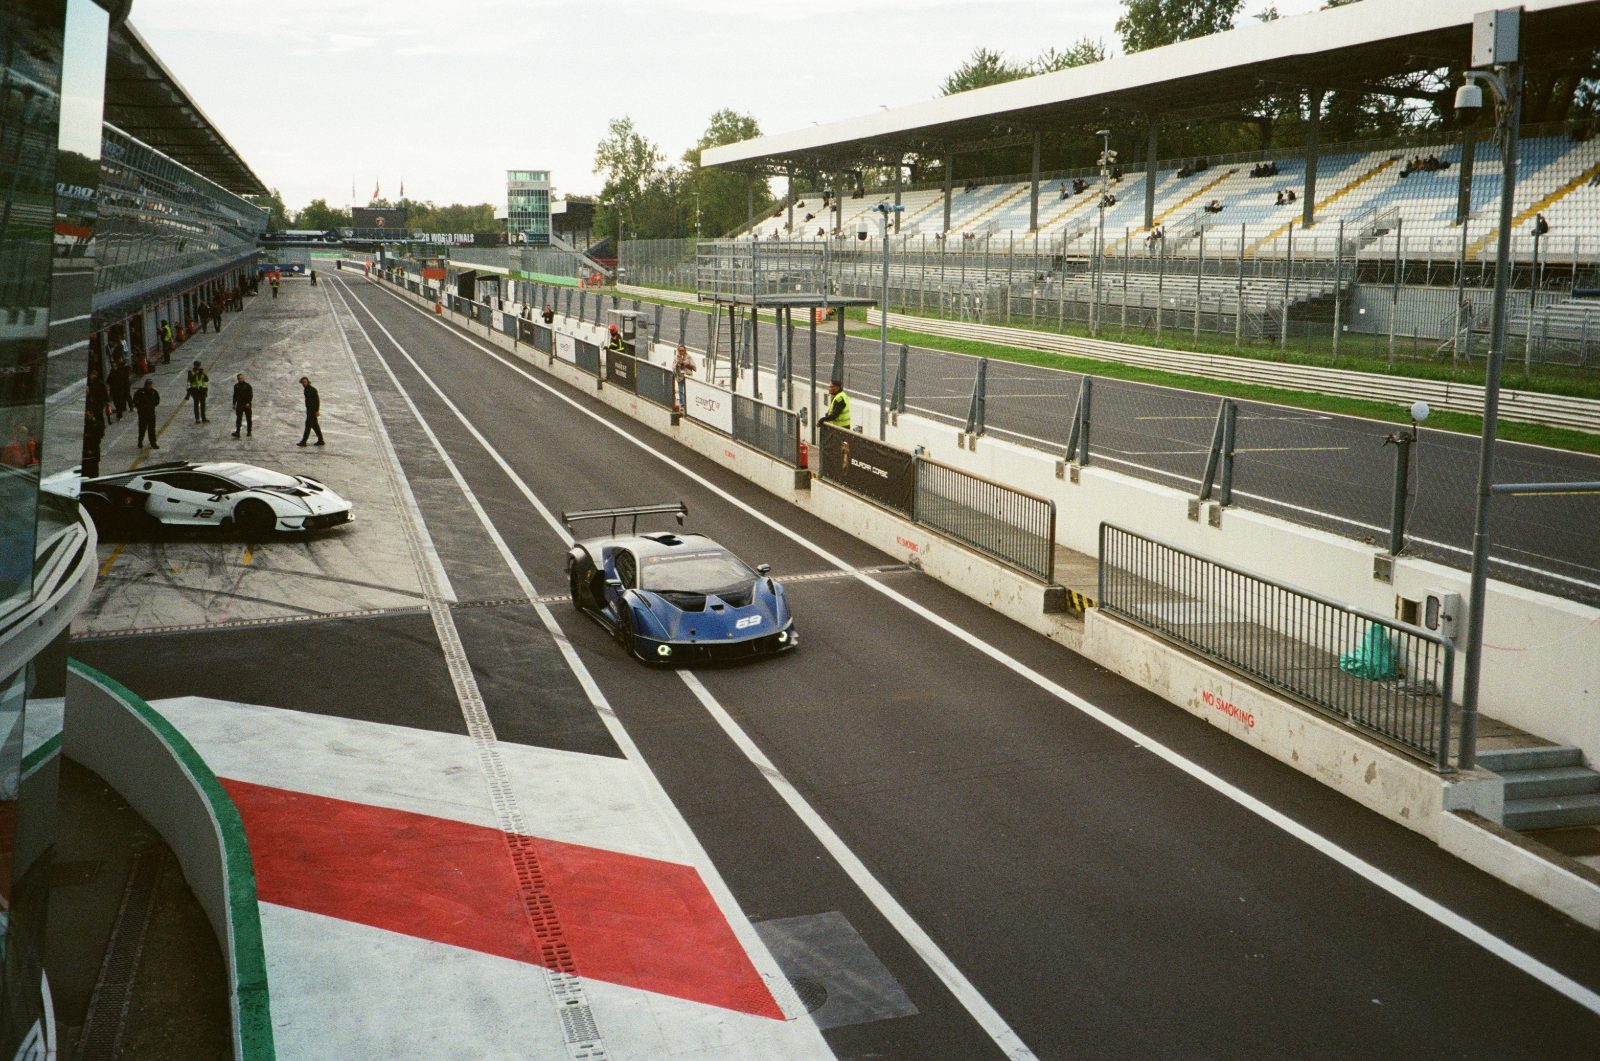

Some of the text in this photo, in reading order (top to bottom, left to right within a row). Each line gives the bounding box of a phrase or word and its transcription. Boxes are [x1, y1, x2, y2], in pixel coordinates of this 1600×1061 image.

[454, 233, 475, 244] FINALS
[192, 508, 215, 519] 12
[736, 614, 762, 629] 69
[1202, 690, 1255, 728] NO SMOKING
